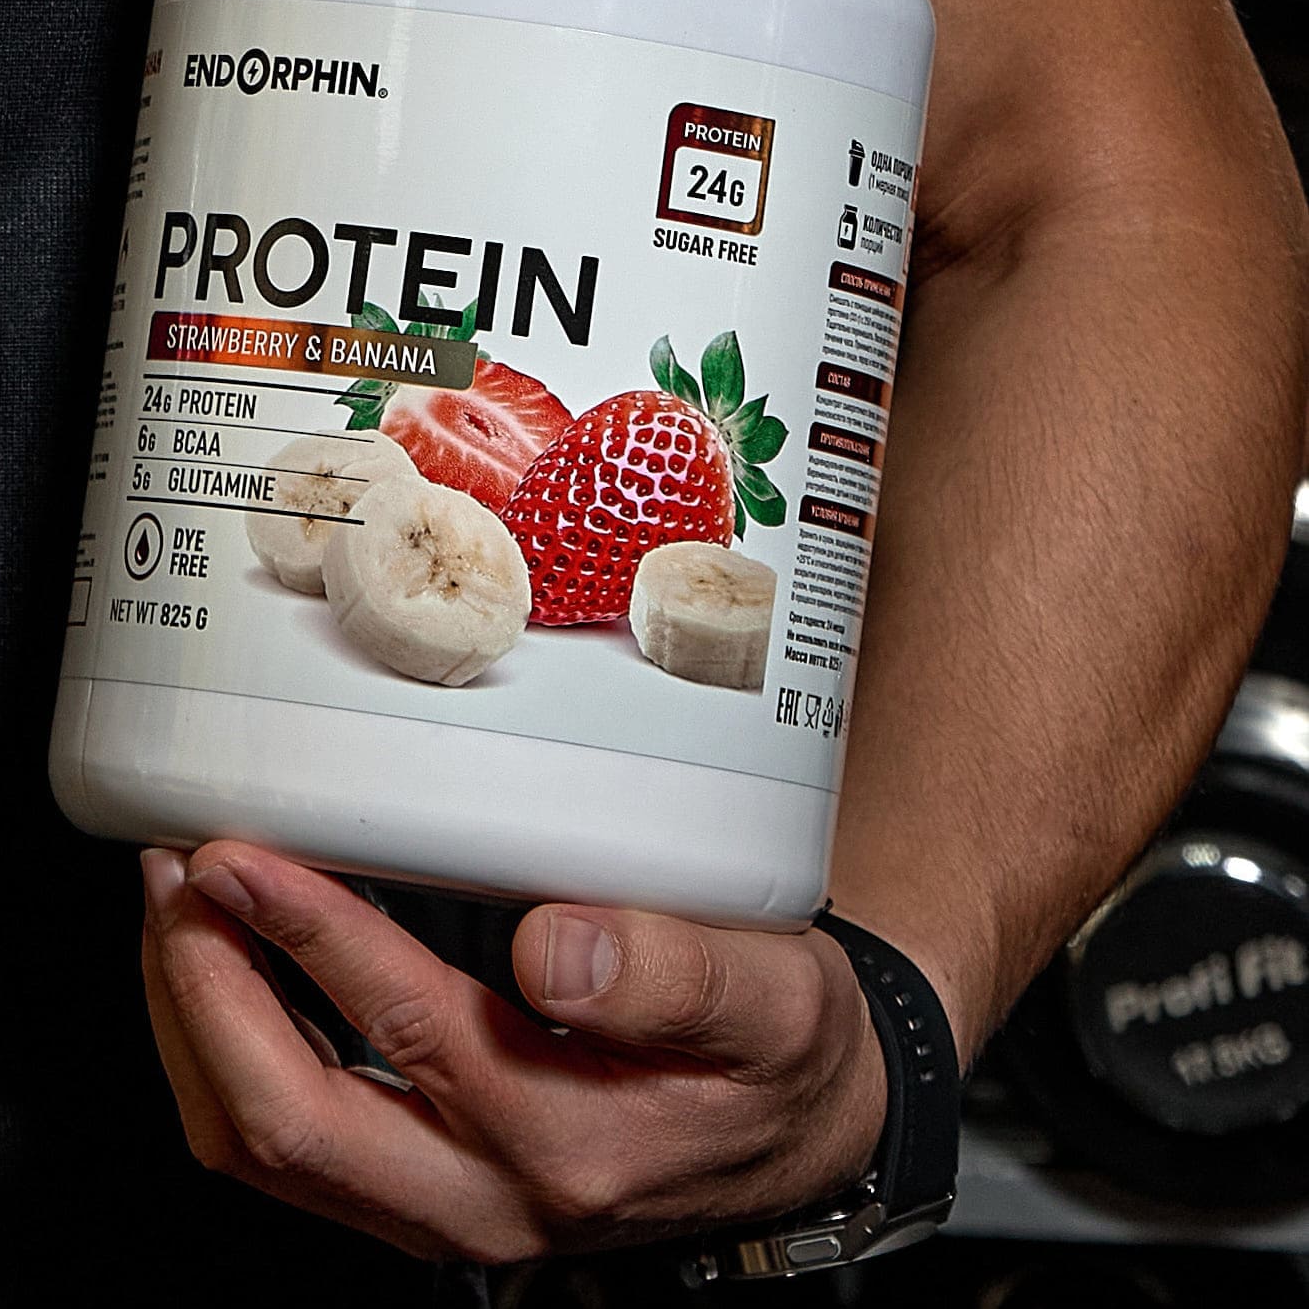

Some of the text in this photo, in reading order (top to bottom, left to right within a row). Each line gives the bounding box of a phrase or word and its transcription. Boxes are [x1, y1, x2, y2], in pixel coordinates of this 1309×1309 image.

[183, 47, 381, 99] ENDORPHIN
[683, 121, 762, 152] PROTEIN
[686, 164, 746, 207] 24G
[652, 226, 759, 267] SUGAR FREE
[152, 210, 599, 348] PROTEIN
[166, 323, 437, 376] STRAWBERRY & BANANA
[178, 388, 257, 421] PROTEIN
[172, 430, 221, 458] BCAA
[167, 467, 277, 503] GLUTAMINE
[172, 527, 206, 553] DYE
[169, 551, 210, 579] FREE
[109, 598, 209, 631] NET WT 825 G
